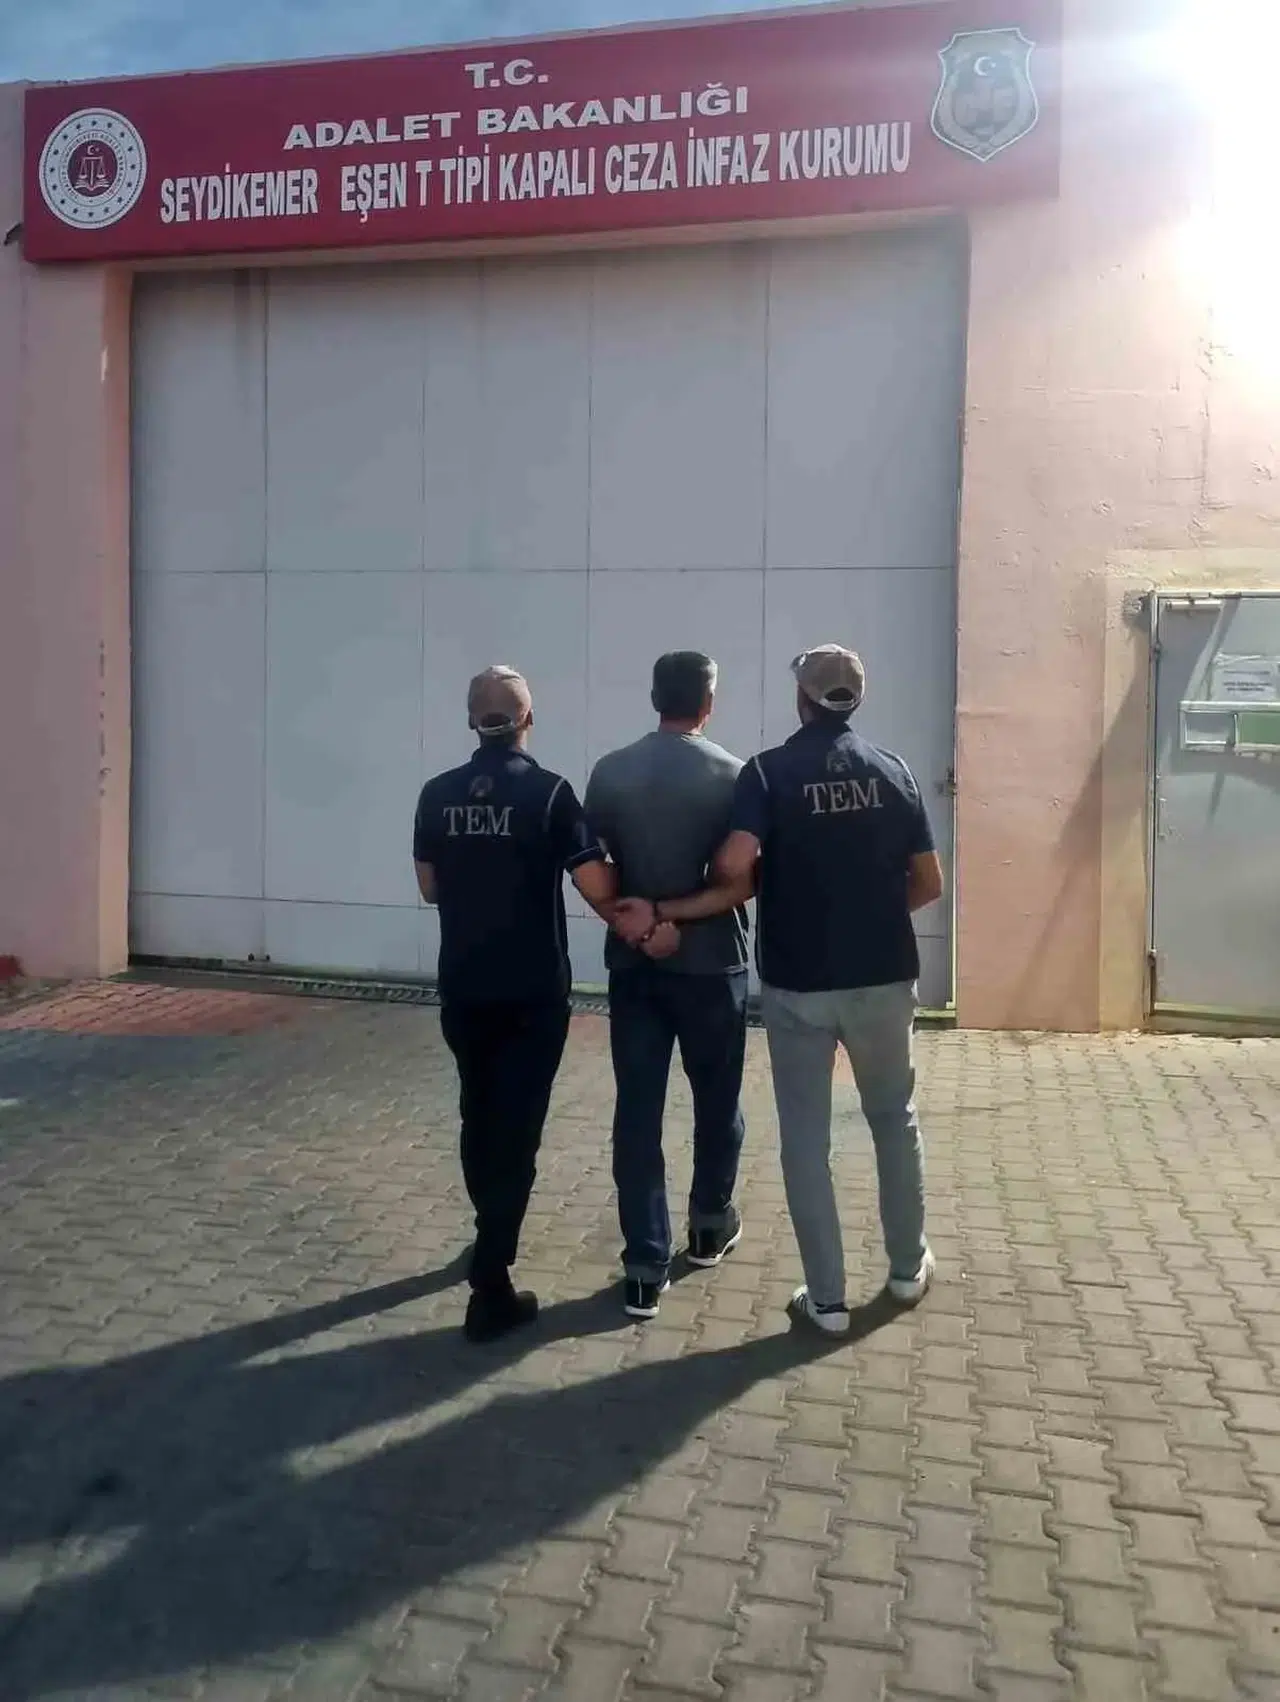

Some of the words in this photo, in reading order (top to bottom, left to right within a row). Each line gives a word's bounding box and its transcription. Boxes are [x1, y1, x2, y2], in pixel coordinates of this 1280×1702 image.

[465, 58, 549, 88] T.C.
[283, 111, 461, 150] ADALET
[477, 83, 748, 136] BAKANLIĞI
[160, 163, 318, 224] SEYDİKEMER
[340, 162, 407, 223] EŞEN
[415, 161, 433, 206] T
[439, 144, 490, 205] TİPİ
[499, 147, 595, 201] KAPALI
[605, 141, 678, 197] CEZA
[687, 127, 770, 187] İNFAZ
[779, 121, 912, 181] KURUMU
[803, 777, 884, 814] TEM
[442, 804, 515, 836] TEM
